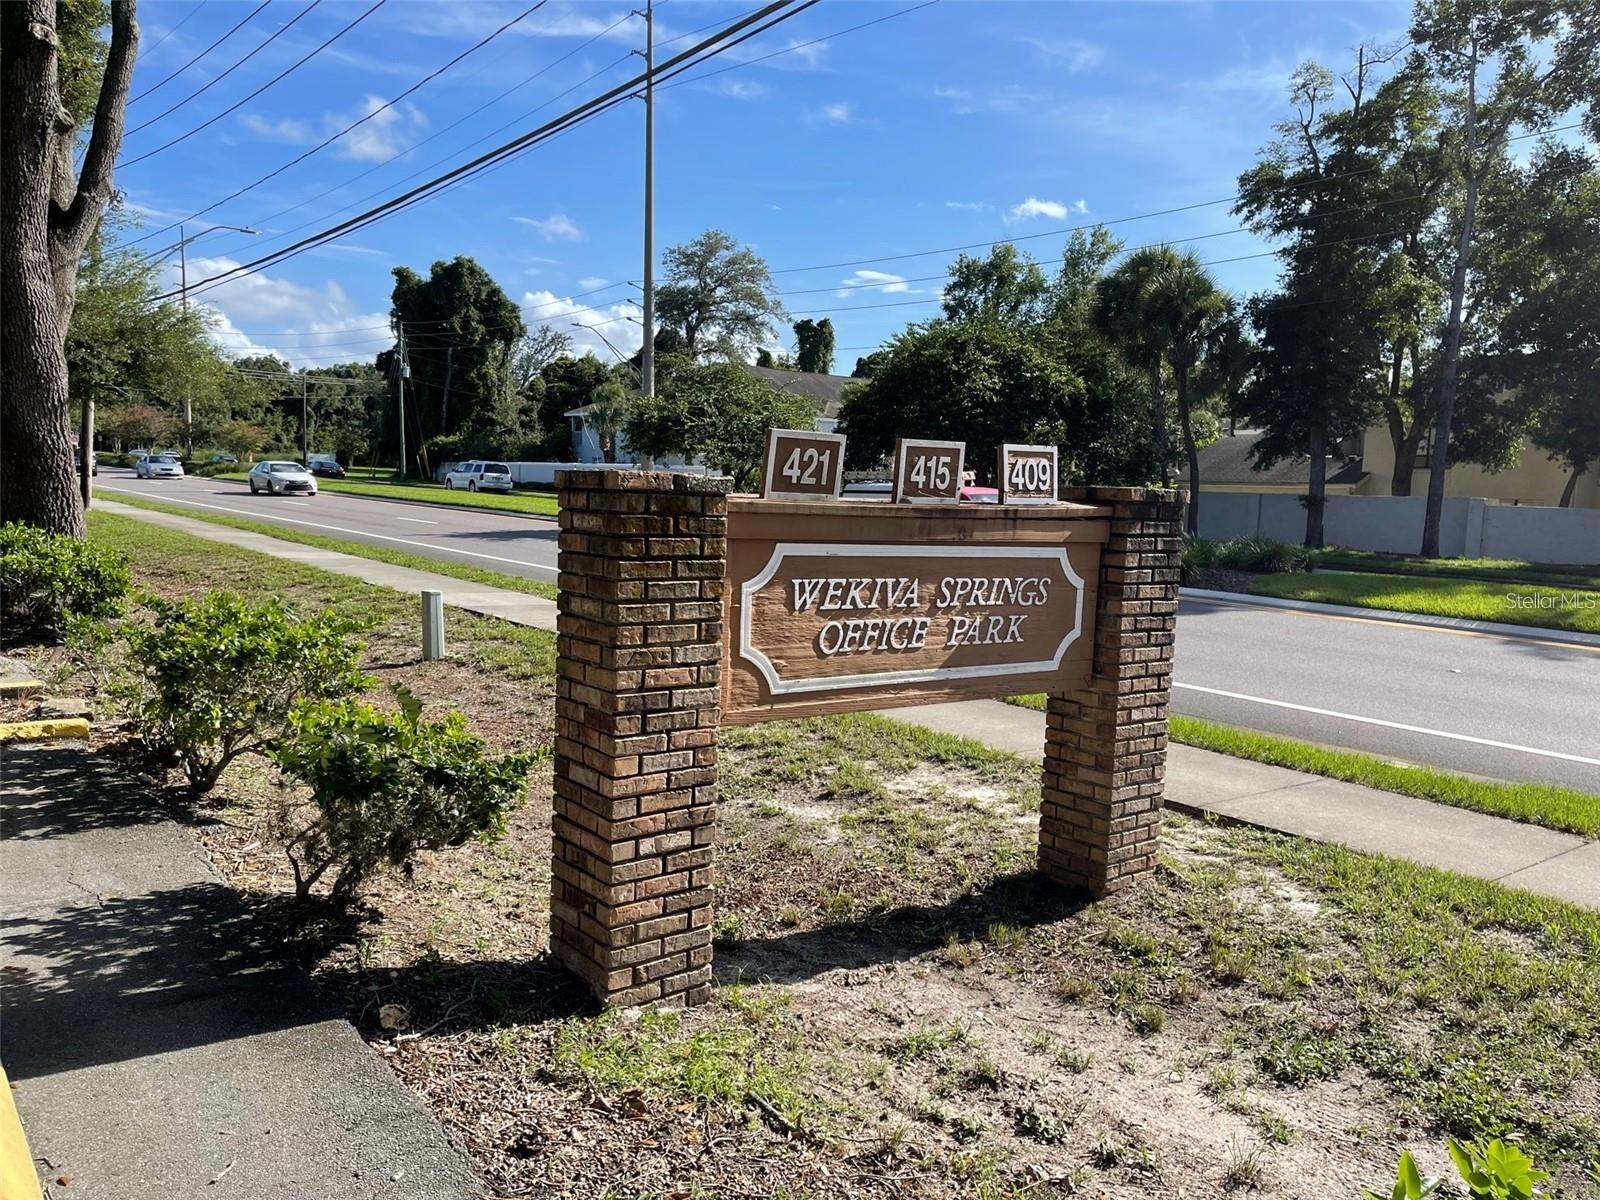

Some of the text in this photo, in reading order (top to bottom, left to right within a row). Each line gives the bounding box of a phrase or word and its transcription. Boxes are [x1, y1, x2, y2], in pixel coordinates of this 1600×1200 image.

[782, 447, 831, 485] 421
[911, 455, 950, 489] 415
[1011, 458, 1051, 491] 409
[791, 577, 1051, 610] WEKIVA SPRINGS
[819, 615, 1028, 655] OFFICE PARK
